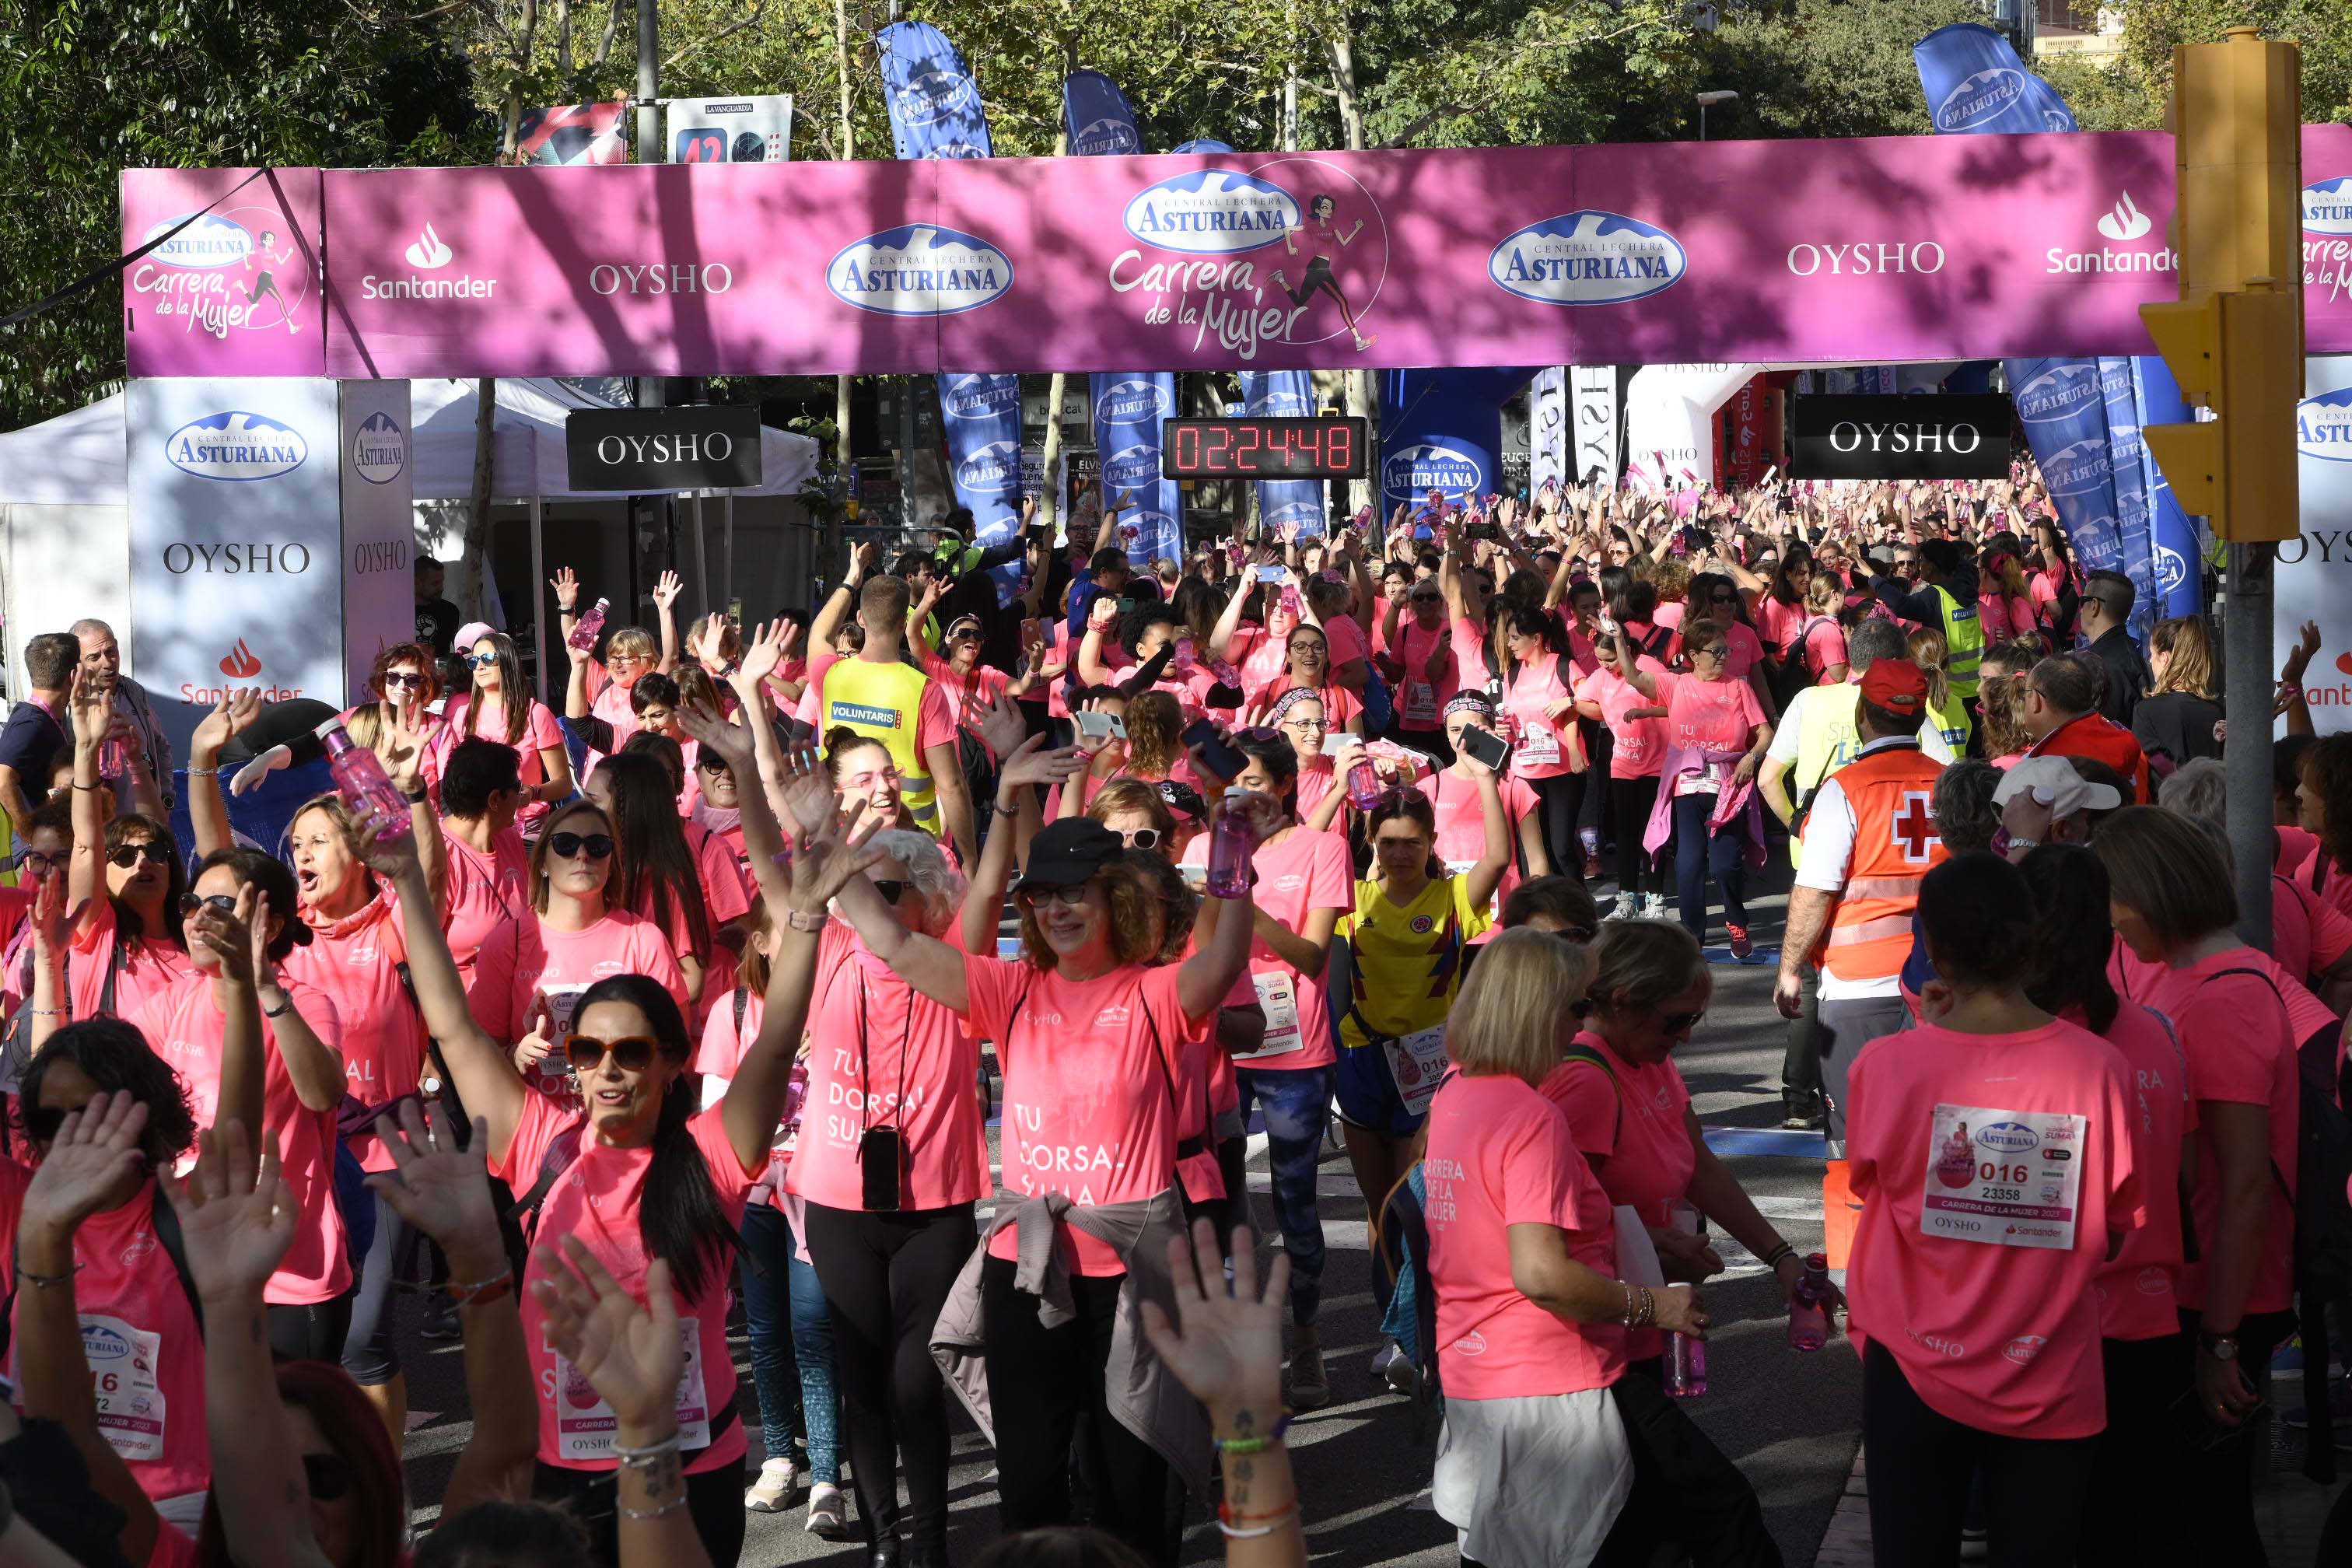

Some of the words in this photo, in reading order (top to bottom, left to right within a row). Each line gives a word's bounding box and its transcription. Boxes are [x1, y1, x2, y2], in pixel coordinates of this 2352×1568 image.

[715, 104, 753, 113] VANGUARDIA
[1164, 198, 1221, 208] CENTRAL
[1224, 196, 1283, 207] LECHERA
[1138, 201, 1286, 233] ASTURIANA
[1534, 243, 1597, 254] CENTRAL
[1601, 241, 1664, 254] LECHERA
[1787, 241, 1945, 276] OYSHO
[870, 255, 927, 265] CENTRAL
[1109, 248, 1253, 293] Carrera
[1503, 246, 1672, 282] ASTURIANA
[133, 264, 226, 294] Carrera
[589, 263, 733, 296] OYSHO
[842, 258, 999, 292] ASTURIANA
[2319, 263, 2333, 284] la
[362, 275, 497, 300] Santander
[156, 294, 173, 315] de
[176, 293, 190, 315] la
[187, 291, 261, 338] Mujer
[1144, 294, 1171, 326] de
[1177, 294, 1198, 325] la
[1193, 288, 1310, 360] Mujer
[596, 432, 733, 464] OYSHO
[1177, 425, 1351, 470] 02:24:48
[1829, 421, 1981, 454] OYSHO
[176, 437, 298, 464] ASTURIANA
[357, 439, 402, 467] ASTURIANA
[1386, 472, 1475, 488] ASTURIANA
[163, 543, 311, 575] OYSHO
[355, 539, 406, 575] OYSHO
[180, 684, 303, 705] Santder
[832, 705, 894, 723] VOLUNTARIS
[1679, 724, 1695, 736] TU
[1263, 1030, 1278, 1039] UJER
[1266, 1039, 1295, 1049] Santander
[833, 1048, 862, 1077] TU
[1422, 1055, 1449, 1073] 016
[828, 1081, 927, 1115] DORSAL
[827, 1114, 863, 1143] SU
[1013, 1103, 1041, 1132] TU
[1980, 1130, 2035, 1146] ASTURIANA
[2045, 1132, 2073, 1141] SUMA
[1020, 1140, 1125, 1173] DORSAL
[1979, 1162, 2028, 1184] 016
[1439, 1181, 1454, 1200] LA
[1982, 1187, 2021, 1201] 23358
[1941, 1199, 1982, 1212] CARRERA
[1983, 1205, 1997, 1213] DE
[1997, 1206, 2009, 1214] LA
[2010, 1207, 2039, 1216] MUJER
[2041, 1209, 2060, 1218] 2023
[1934, 1216, 1982, 1233] OYSHO
[2018, 1226, 2062, 1238] Santander
[98, 1416, 128, 1426] MUJER
[131, 1420, 151, 1430] 2023
[576, 1420, 616, 1430] CARRERA
